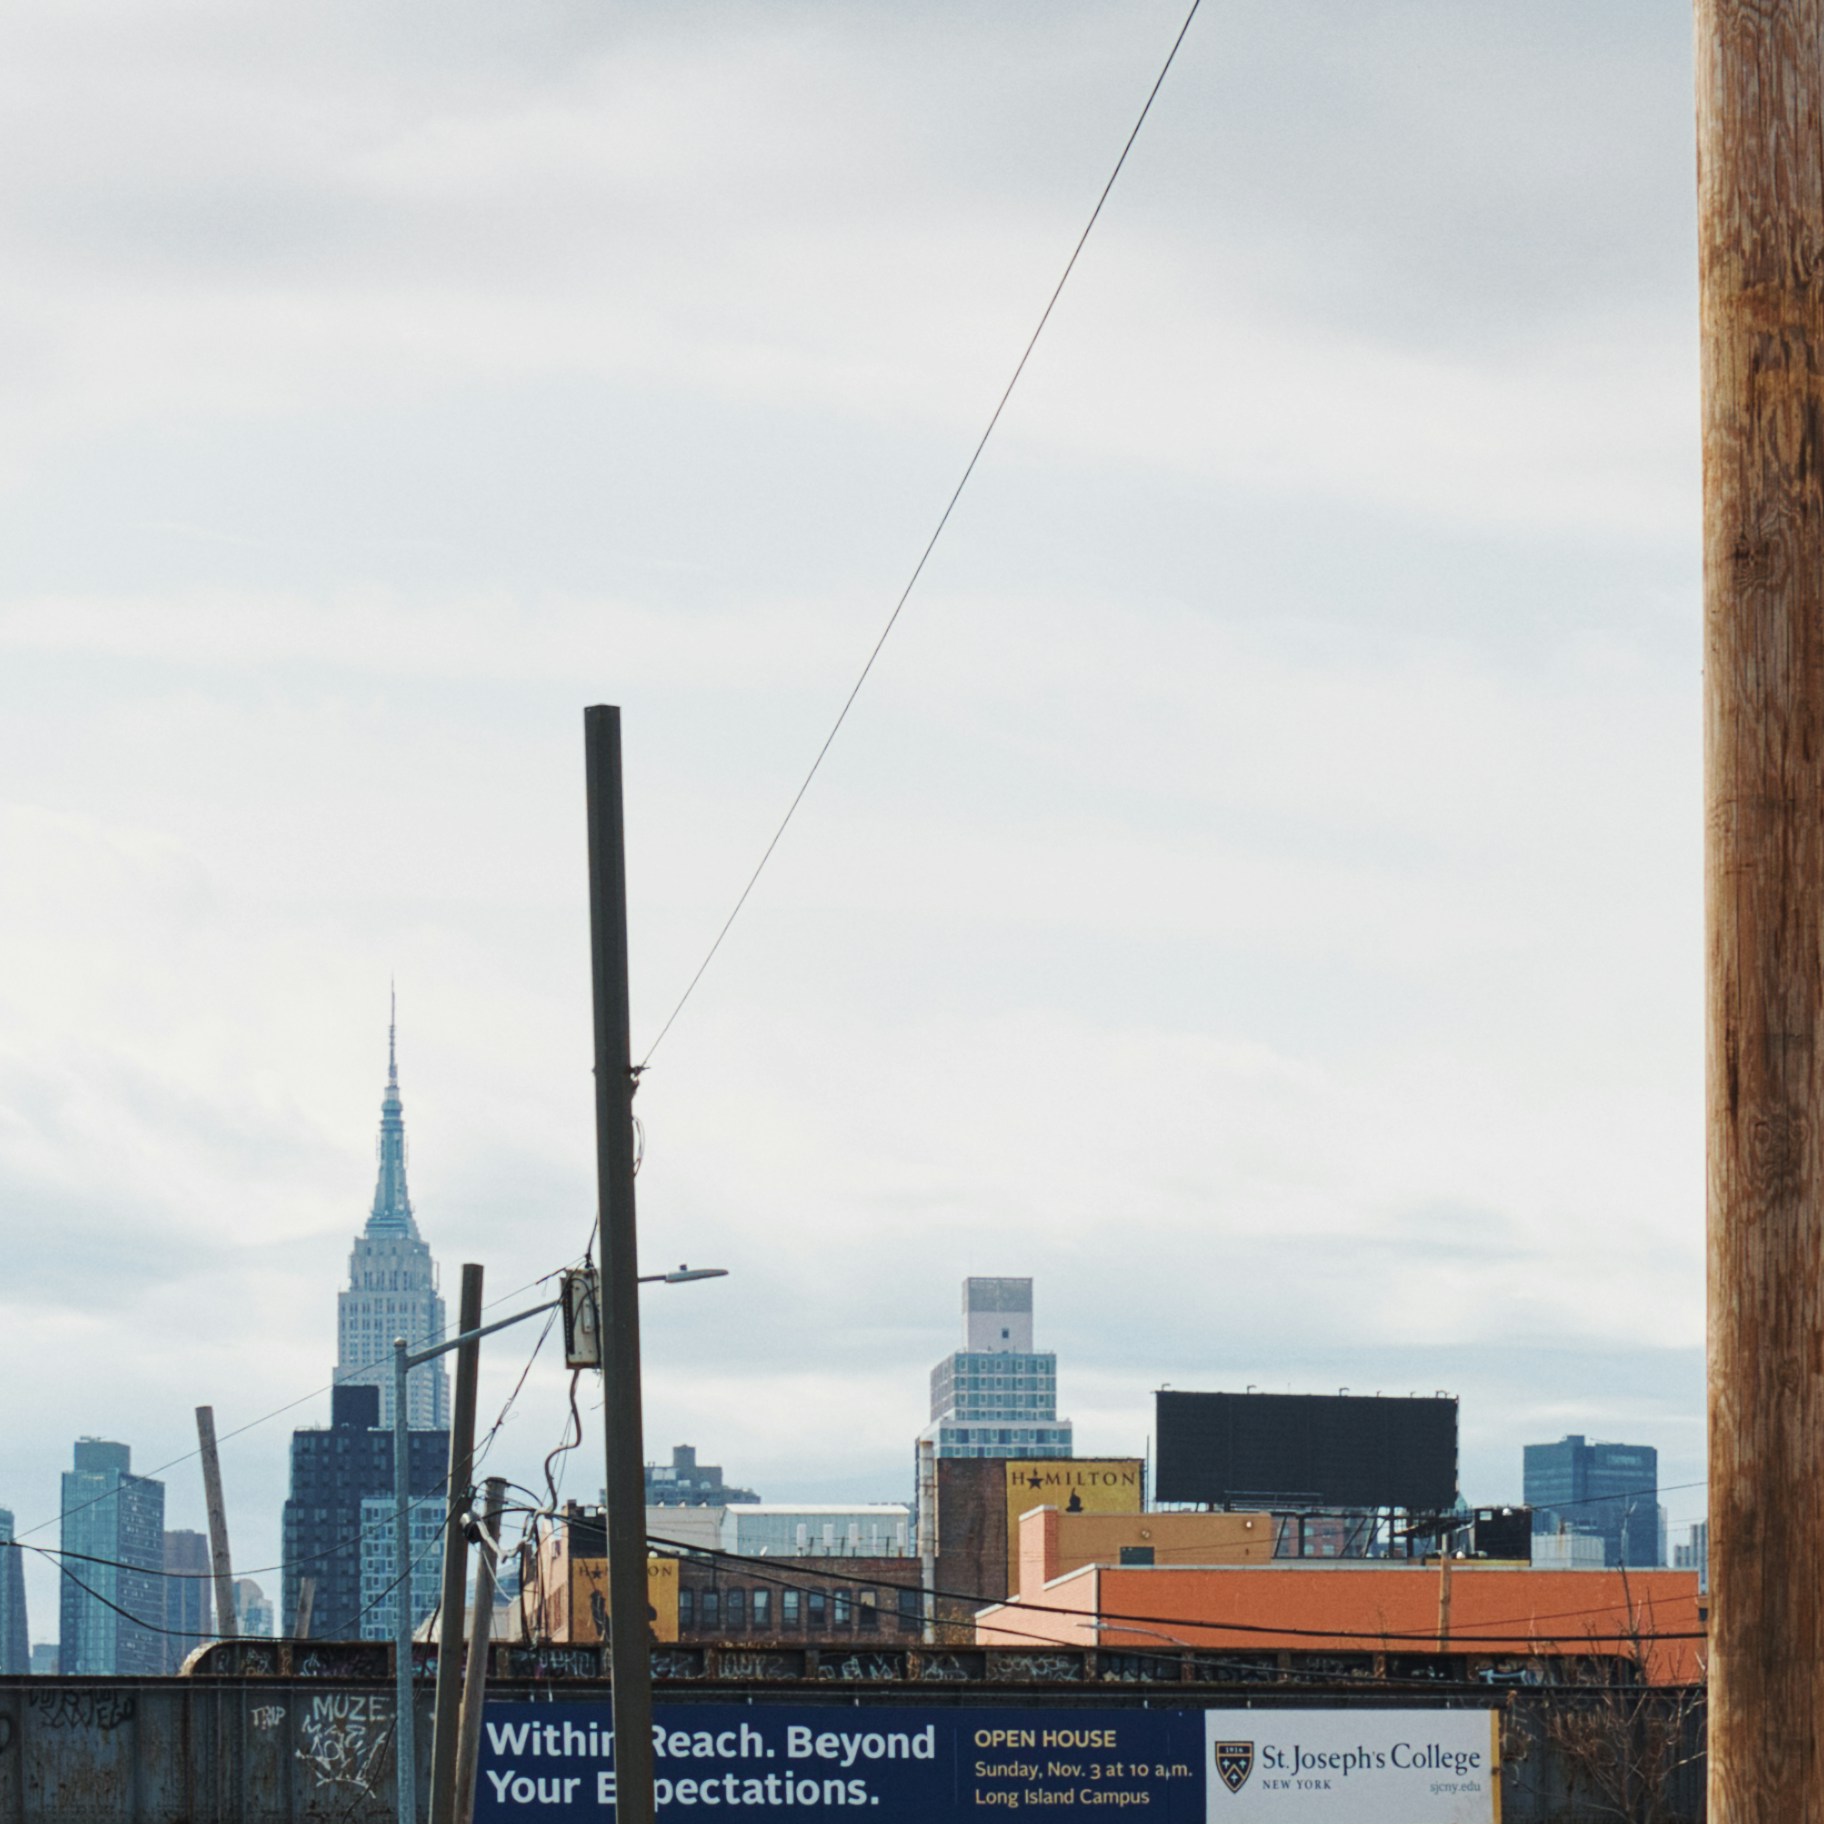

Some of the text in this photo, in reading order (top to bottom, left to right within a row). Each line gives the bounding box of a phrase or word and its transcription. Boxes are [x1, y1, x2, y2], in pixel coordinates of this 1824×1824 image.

[486, 1721, 936, 1768] Within Reach. Beyond
[974, 1729, 1117, 1748] OPEN HOUSE
[1262, 1742, 1481, 1776] St. Joseph's College
[975, 1760, 1193, 1781] Sunday, Nov. 3 at 10 a.m.
[486, 1770, 880, 1813] Your Epectations.
[1262, 1779, 1332, 1790] NEW YORK
[1429, 1781, 1481, 1795] sjcny.edu
[975, 1788, 1150, 1808] Long Island Campus
